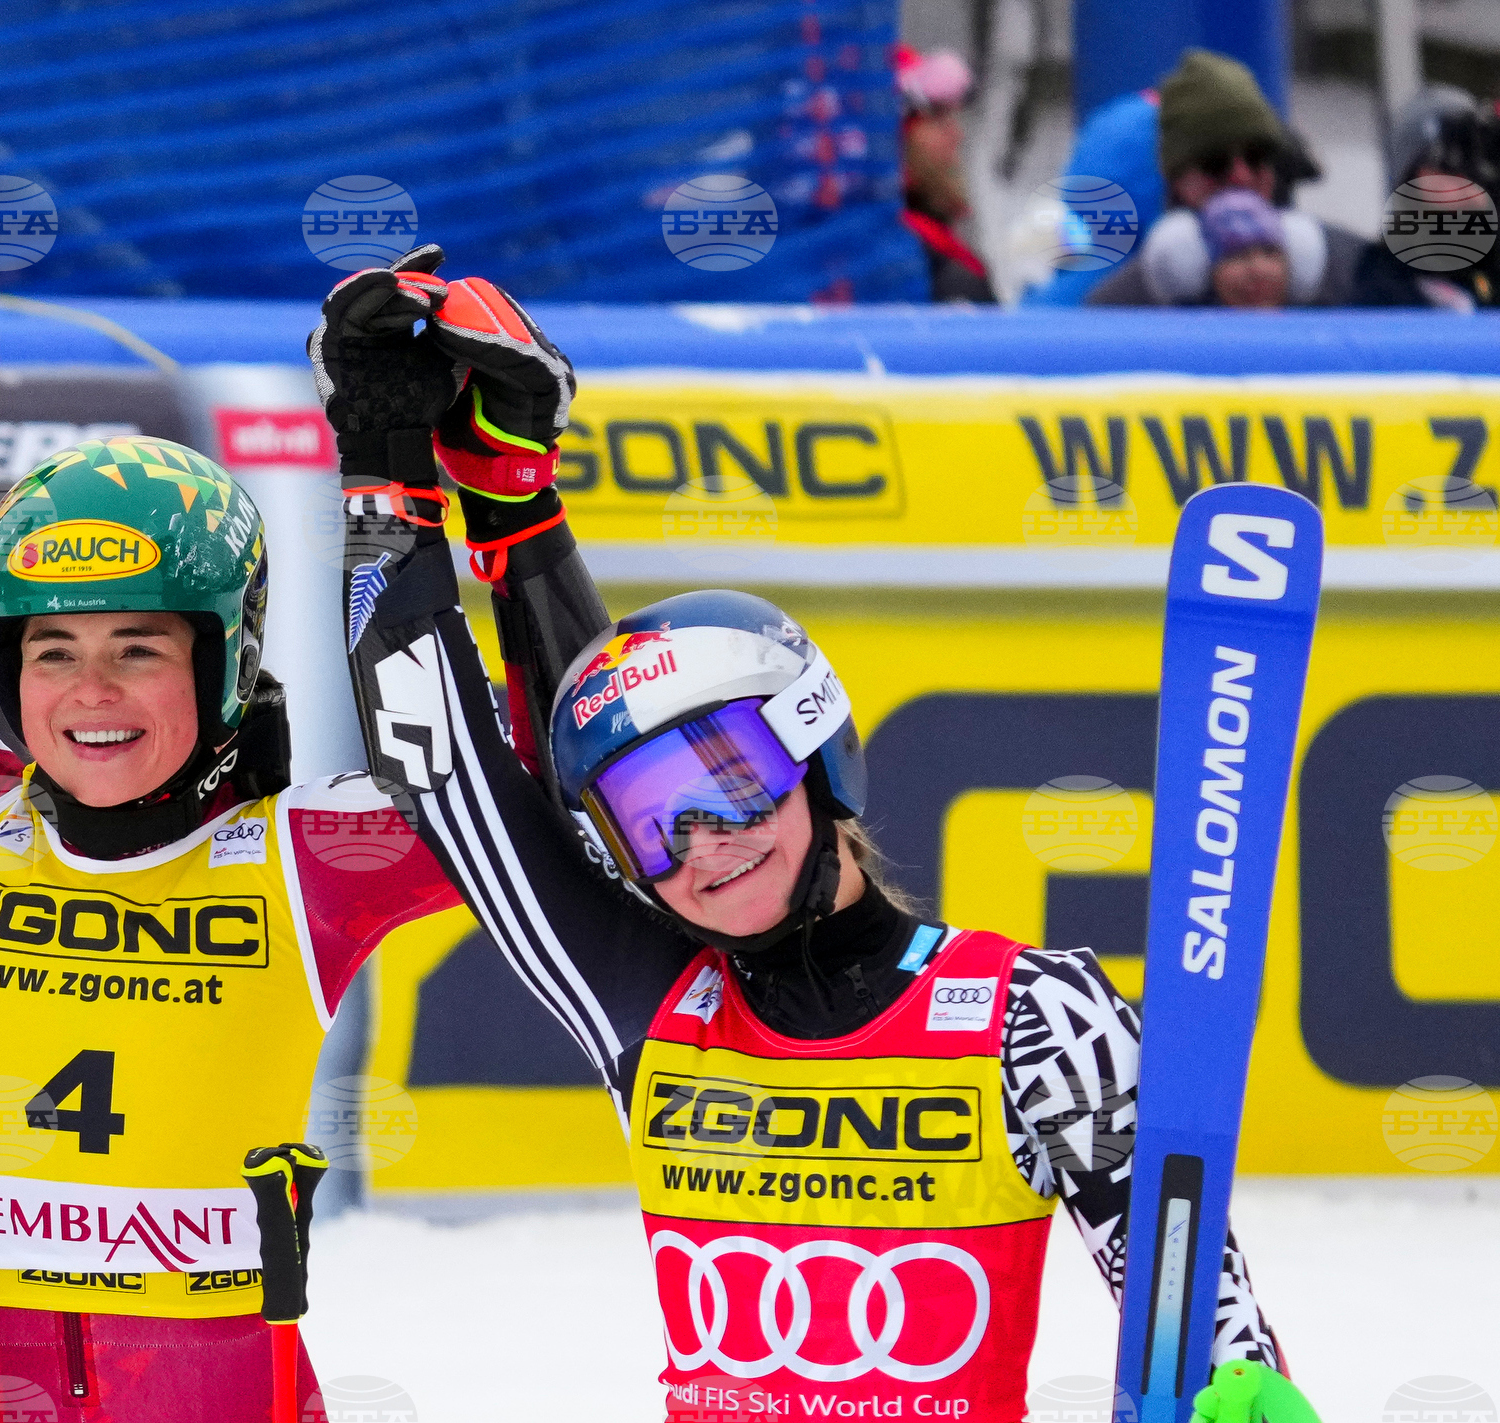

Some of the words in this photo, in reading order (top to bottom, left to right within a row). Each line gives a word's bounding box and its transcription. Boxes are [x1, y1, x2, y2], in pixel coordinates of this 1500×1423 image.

[556, 420, 888, 498] GONC
[41, 537, 140, 564] RAUCH
[61, 565, 77, 573] SEIT
[63, 599, 76, 607] Ski
[78, 598, 106, 607] Austria
[572, 671, 623, 730] Red
[622, 650, 678, 692] Bull
[1182, 645, 1258, 980] SALOMON
[24, 1049, 125, 1155] 4
[647, 1082, 972, 1152] ZGONC
[662, 1164, 936, 1203] www.zgonc.at
[190, 1270, 262, 1292] ZGON
[705, 1387, 740, 1411] FIS
[748, 1392, 790, 1415] Ski
[799, 1394, 902, 1418] World
[913, 1394, 970, 1420] Cup
